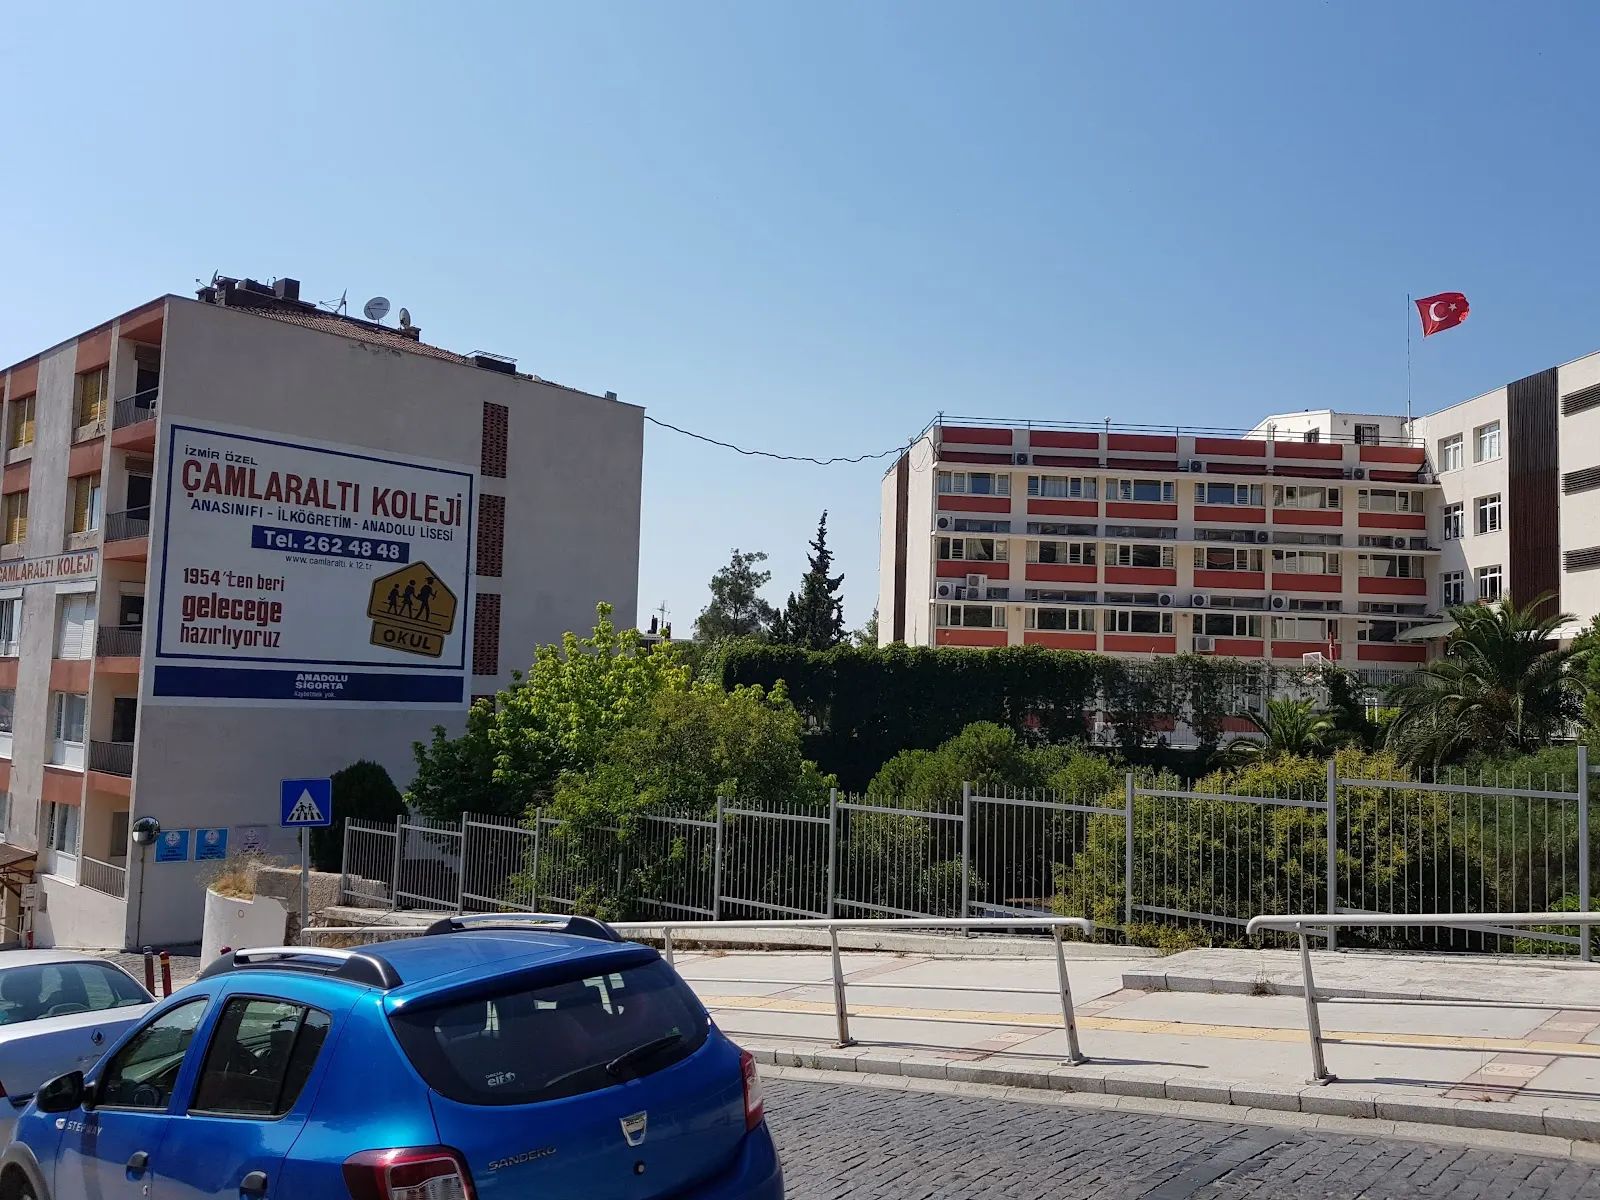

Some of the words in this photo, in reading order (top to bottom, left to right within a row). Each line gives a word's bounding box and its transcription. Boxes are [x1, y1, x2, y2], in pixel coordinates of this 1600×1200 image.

[185, 445, 220, 460] İZMİR
[225, 451, 258, 466] ÖZEL
[182, 459, 360, 513] ÇAMLARALTI
[372, 486, 462, 527] KOLEJİ
[191, 499, 263, 519] ANASINIFI
[278, 507, 352, 529] İLKÖĞRETİM
[362, 519, 415, 537] ANADOLU
[420, 525, 453, 541] LİSESİ
[264, 530, 299, 550] Tel.
[304, 535, 343, 554] 262
[348, 540, 372, 557] 48
[376, 543, 400, 560] 48
[57, 553, 94, 576] KOLEJİ
[257, 574, 285, 592] beri
[182, 592, 282, 626] geleceğe
[180, 622, 281, 650] hazırlıyoruz
[383, 628, 432, 650] OKUL
[295, 673, 349, 682] ANADOLU
[295, 680, 344, 690] SİGORTA
[488, 1145, 557, 1171] SANDERO
